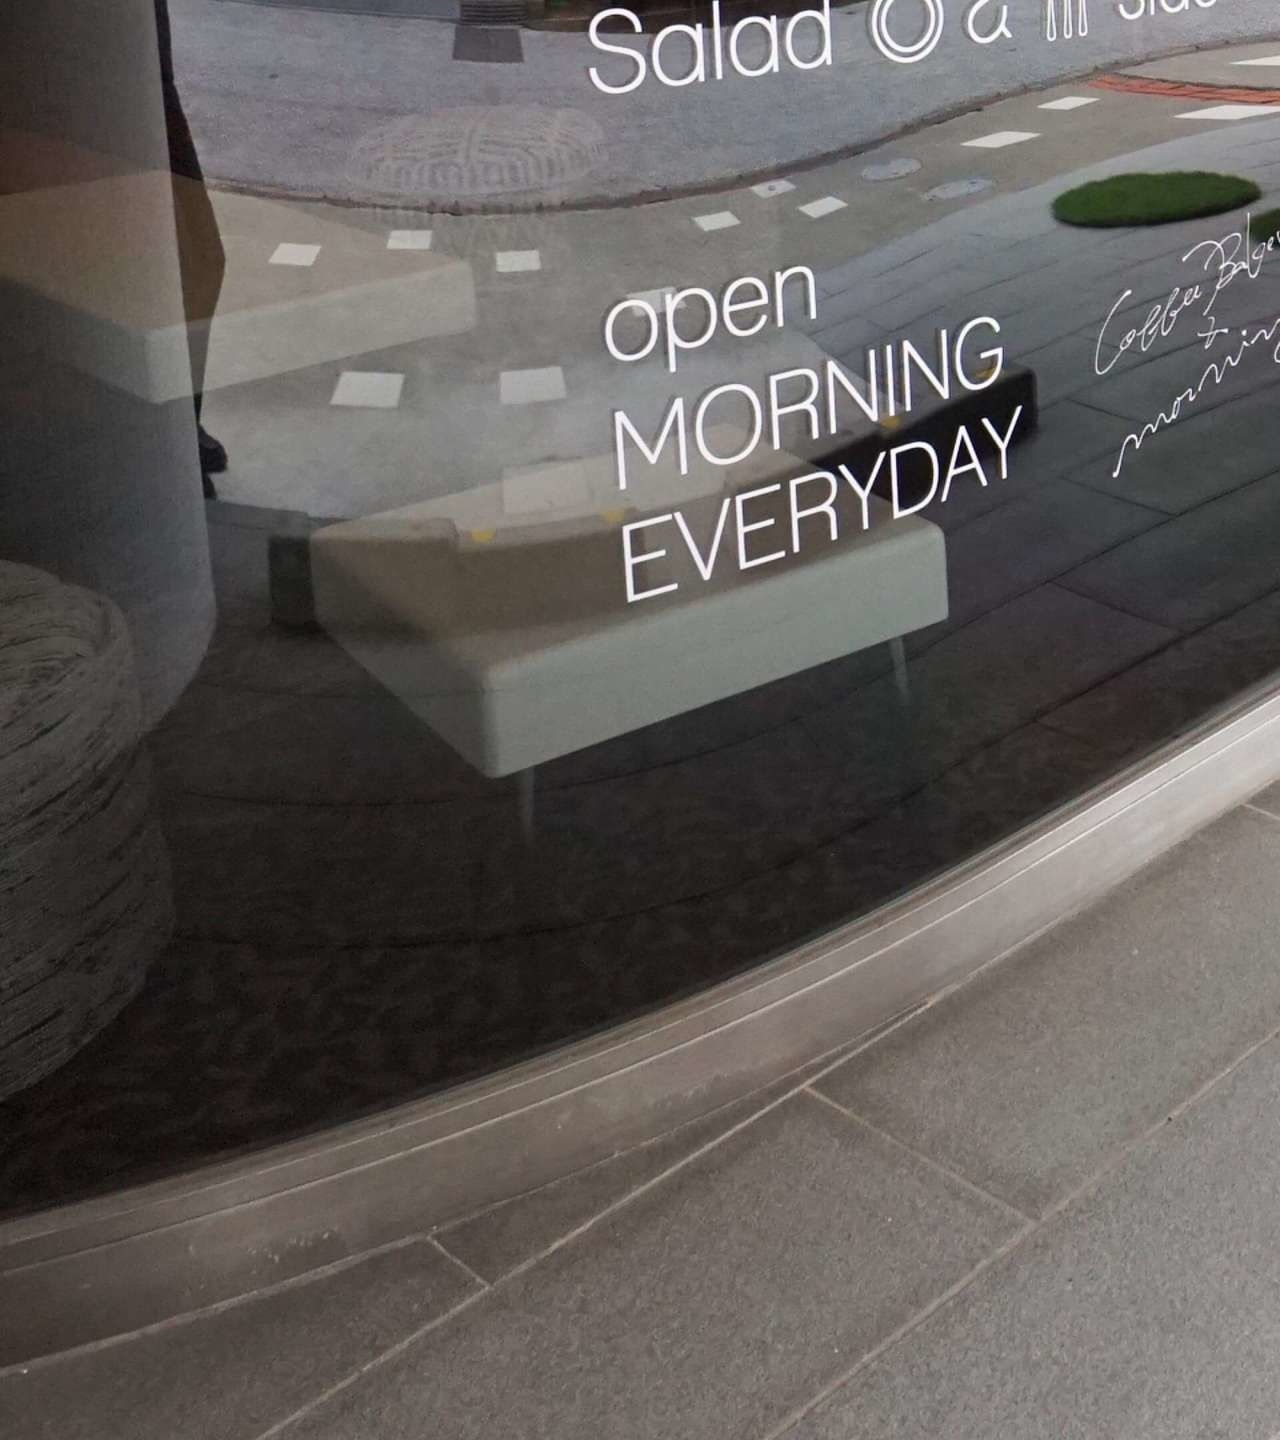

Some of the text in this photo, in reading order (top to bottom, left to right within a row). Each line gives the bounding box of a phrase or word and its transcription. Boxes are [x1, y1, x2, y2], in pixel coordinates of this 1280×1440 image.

[604, 265, 817, 373] open
[614, 316, 1004, 491] MORNING
[622, 405, 1023, 603] EVERYDAY
